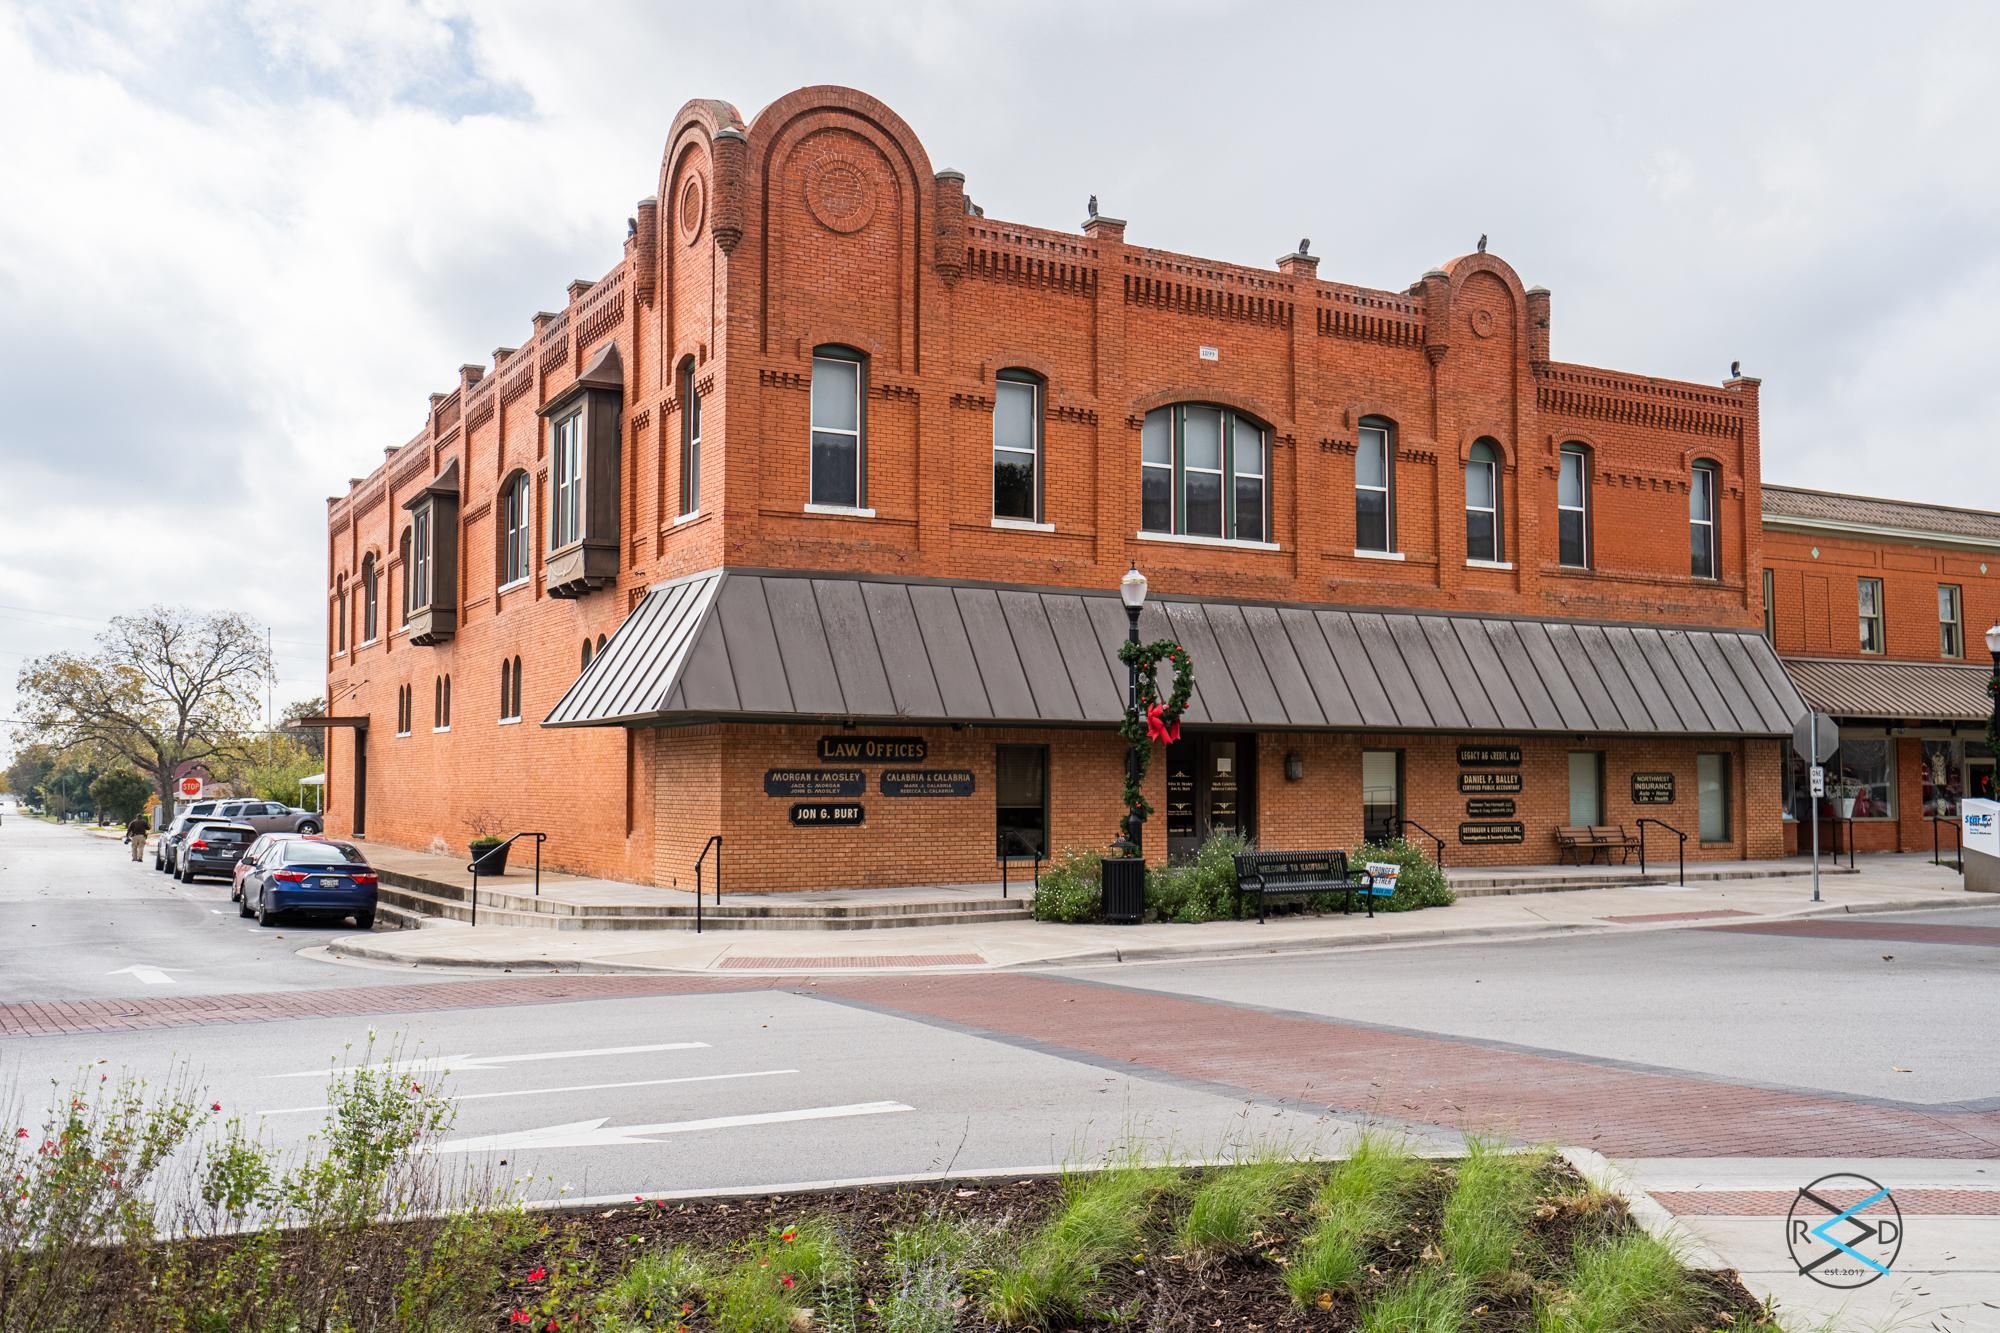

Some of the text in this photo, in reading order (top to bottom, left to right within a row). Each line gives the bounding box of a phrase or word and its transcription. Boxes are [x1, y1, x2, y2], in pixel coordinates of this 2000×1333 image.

[824, 741, 924, 757] LAW OFFICES
[1461, 751, 1480, 760] LEGACY
[1482, 751, 1489, 760] AG
[1510, 751, 1520, 760] ACA
[772, 773, 860, 781] MORGAN & MOSLEY
[886, 773, 924, 782] CALABRIA
[933, 773, 970, 782] CALABRIA
[1464, 775, 1486, 784] DANIEL
[1488, 775, 1494, 784] P.
[183, 783, 200, 791] STOP
[1635, 782, 1672, 790] INSURANCE
[797, 808, 858, 819] JON G. BURT
[1259, 864, 1288, 873] WELCOME
[1290, 863, 1299, 872] TO
